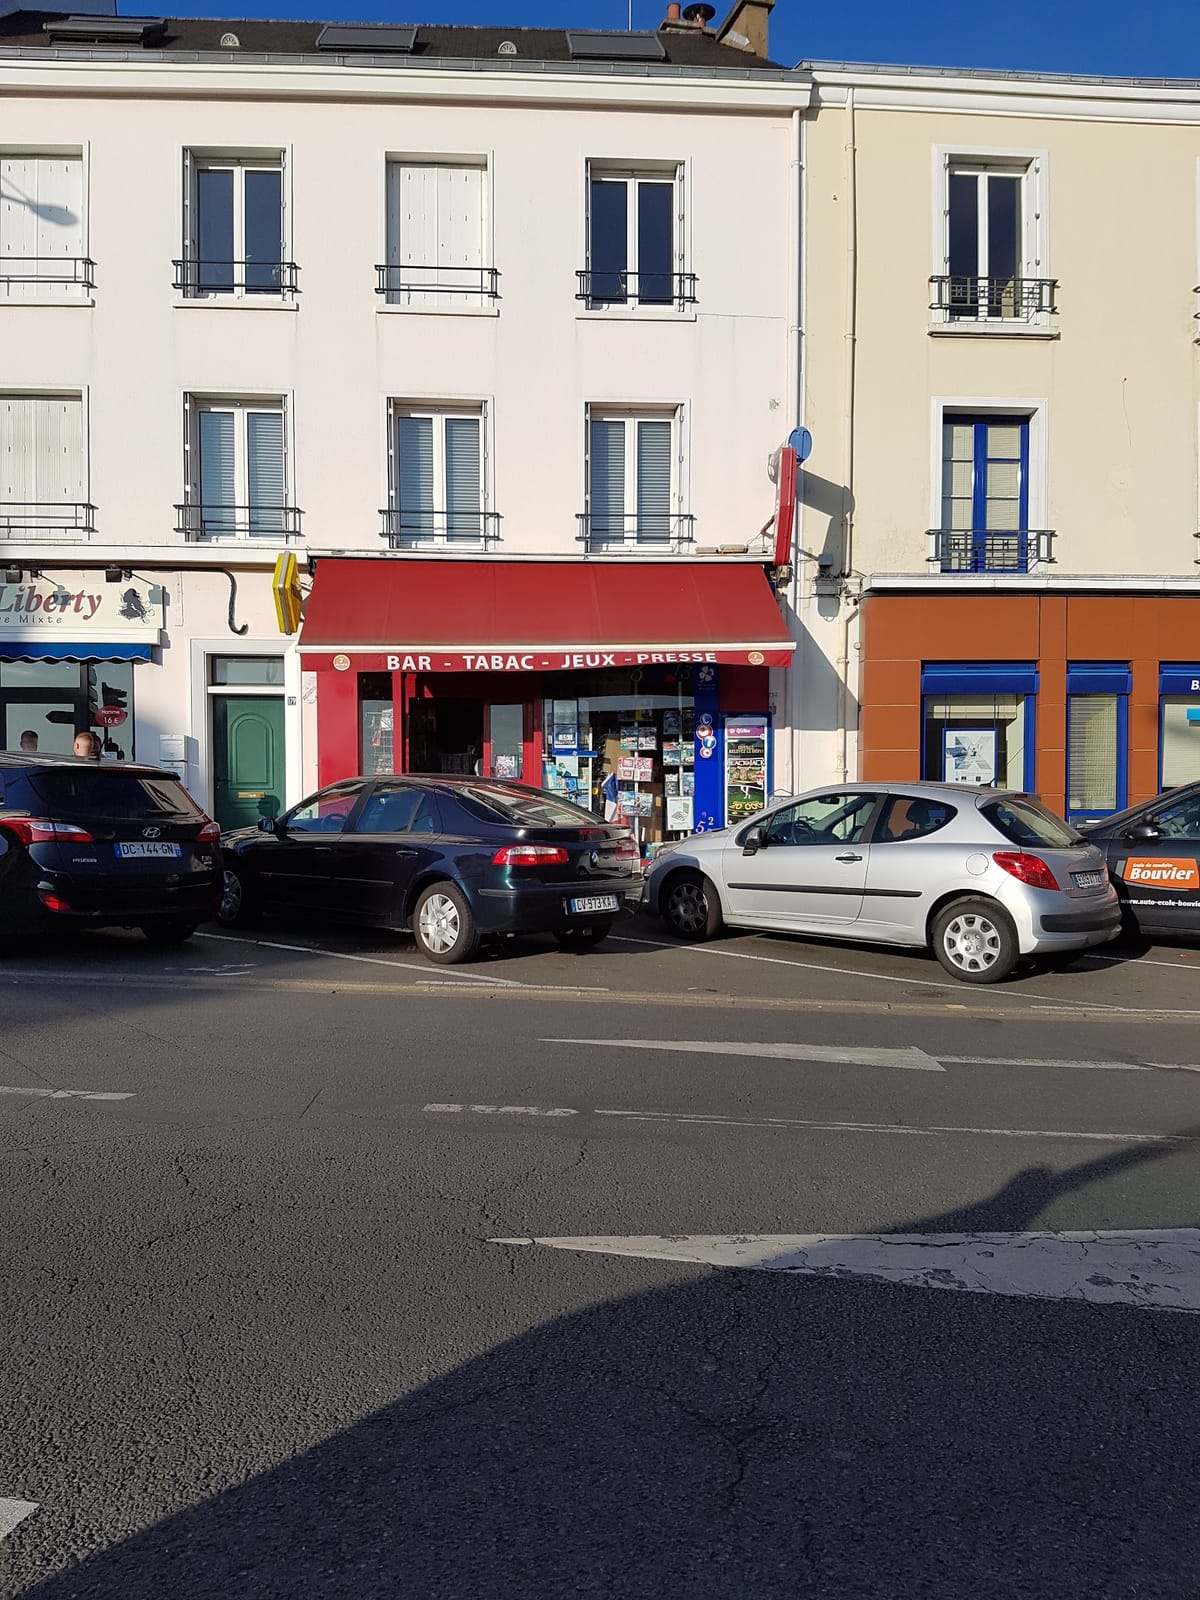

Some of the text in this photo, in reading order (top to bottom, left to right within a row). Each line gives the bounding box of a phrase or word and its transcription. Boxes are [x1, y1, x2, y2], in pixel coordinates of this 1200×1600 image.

[0, 585, 102, 621] Liberty
[19, 615, 63, 624] Mixte
[387, 655, 432, 671] BAR
[462, 655, 535, 670] TABAC
[561, 654, 616, 669] JEUX
[637, 652, 718, 664] PRESSE
[121, 843, 174, 855] DC-144-GN
[1130, 867, 1194, 880] Bouvier
